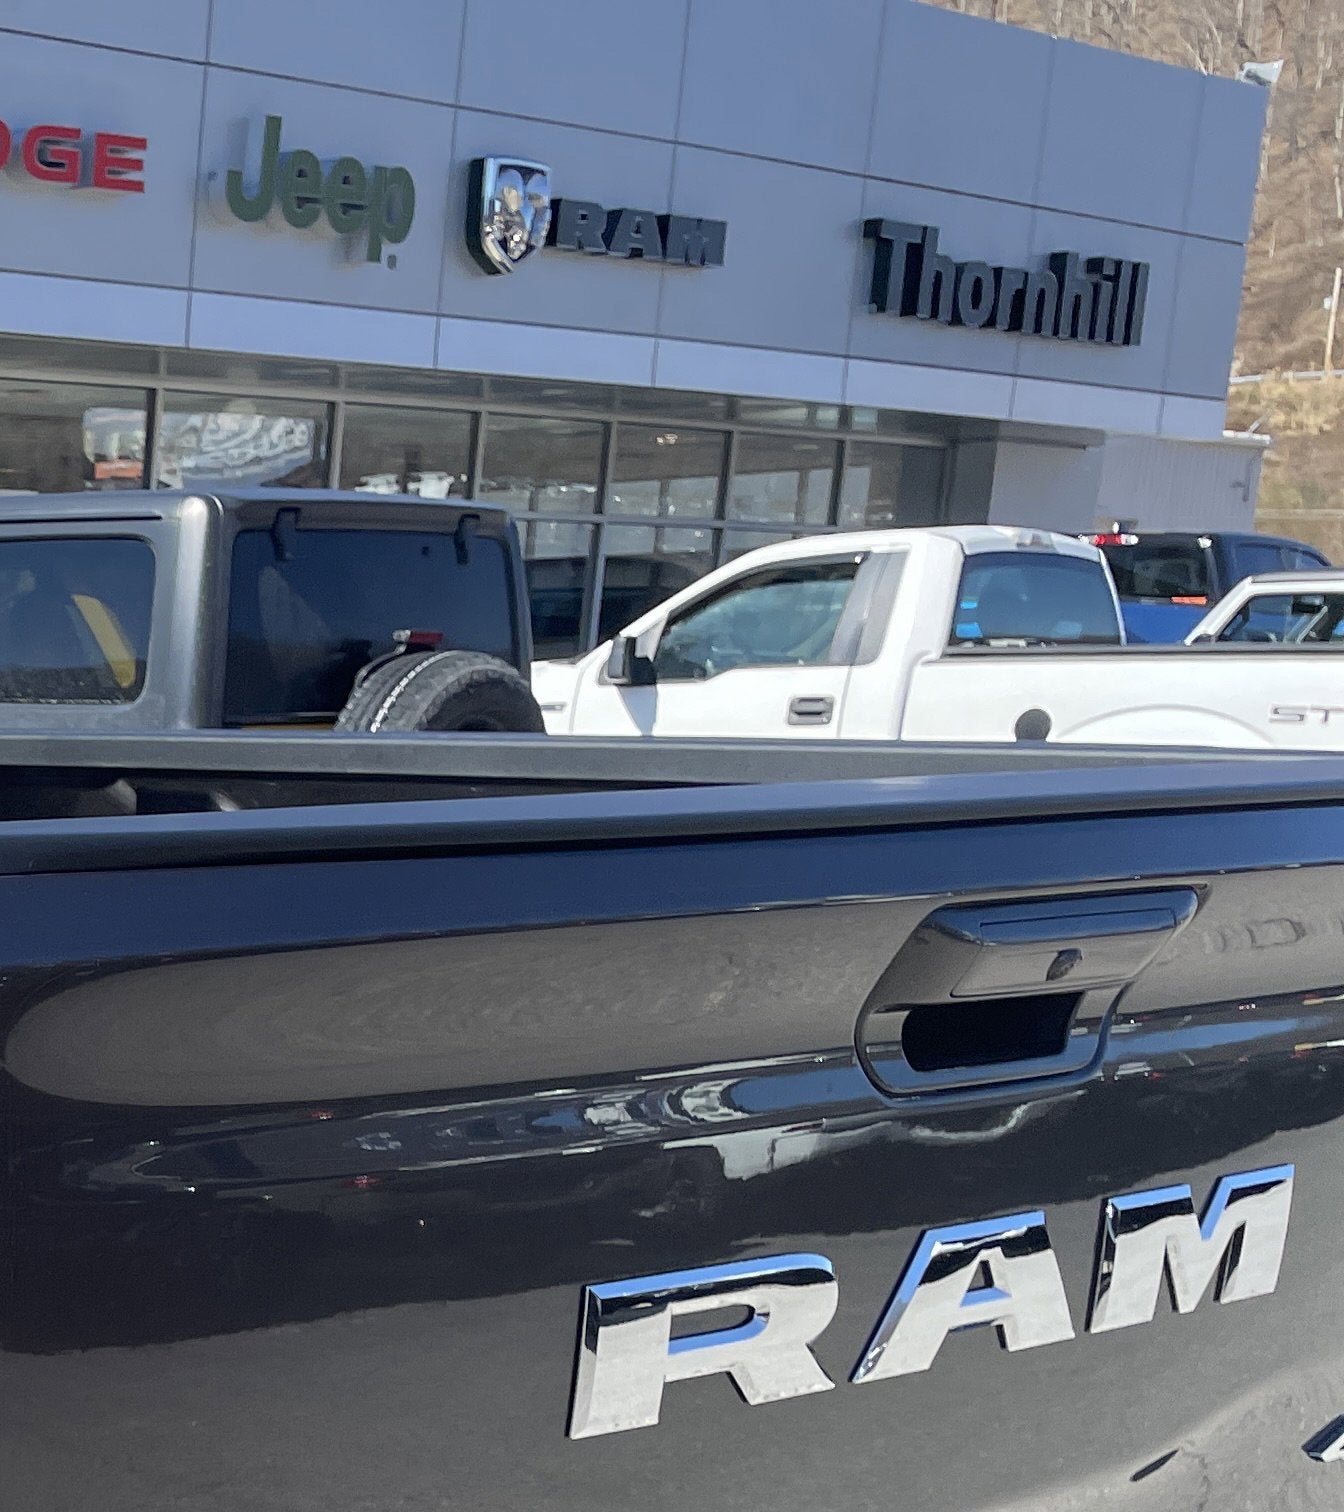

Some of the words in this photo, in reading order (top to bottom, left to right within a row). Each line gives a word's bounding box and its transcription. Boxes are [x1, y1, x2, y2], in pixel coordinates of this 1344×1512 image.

[552, 198, 727, 268] RAM
[864, 219, 1150, 347] Thornhill
[570, 1164, 1296, 1440] RAM
